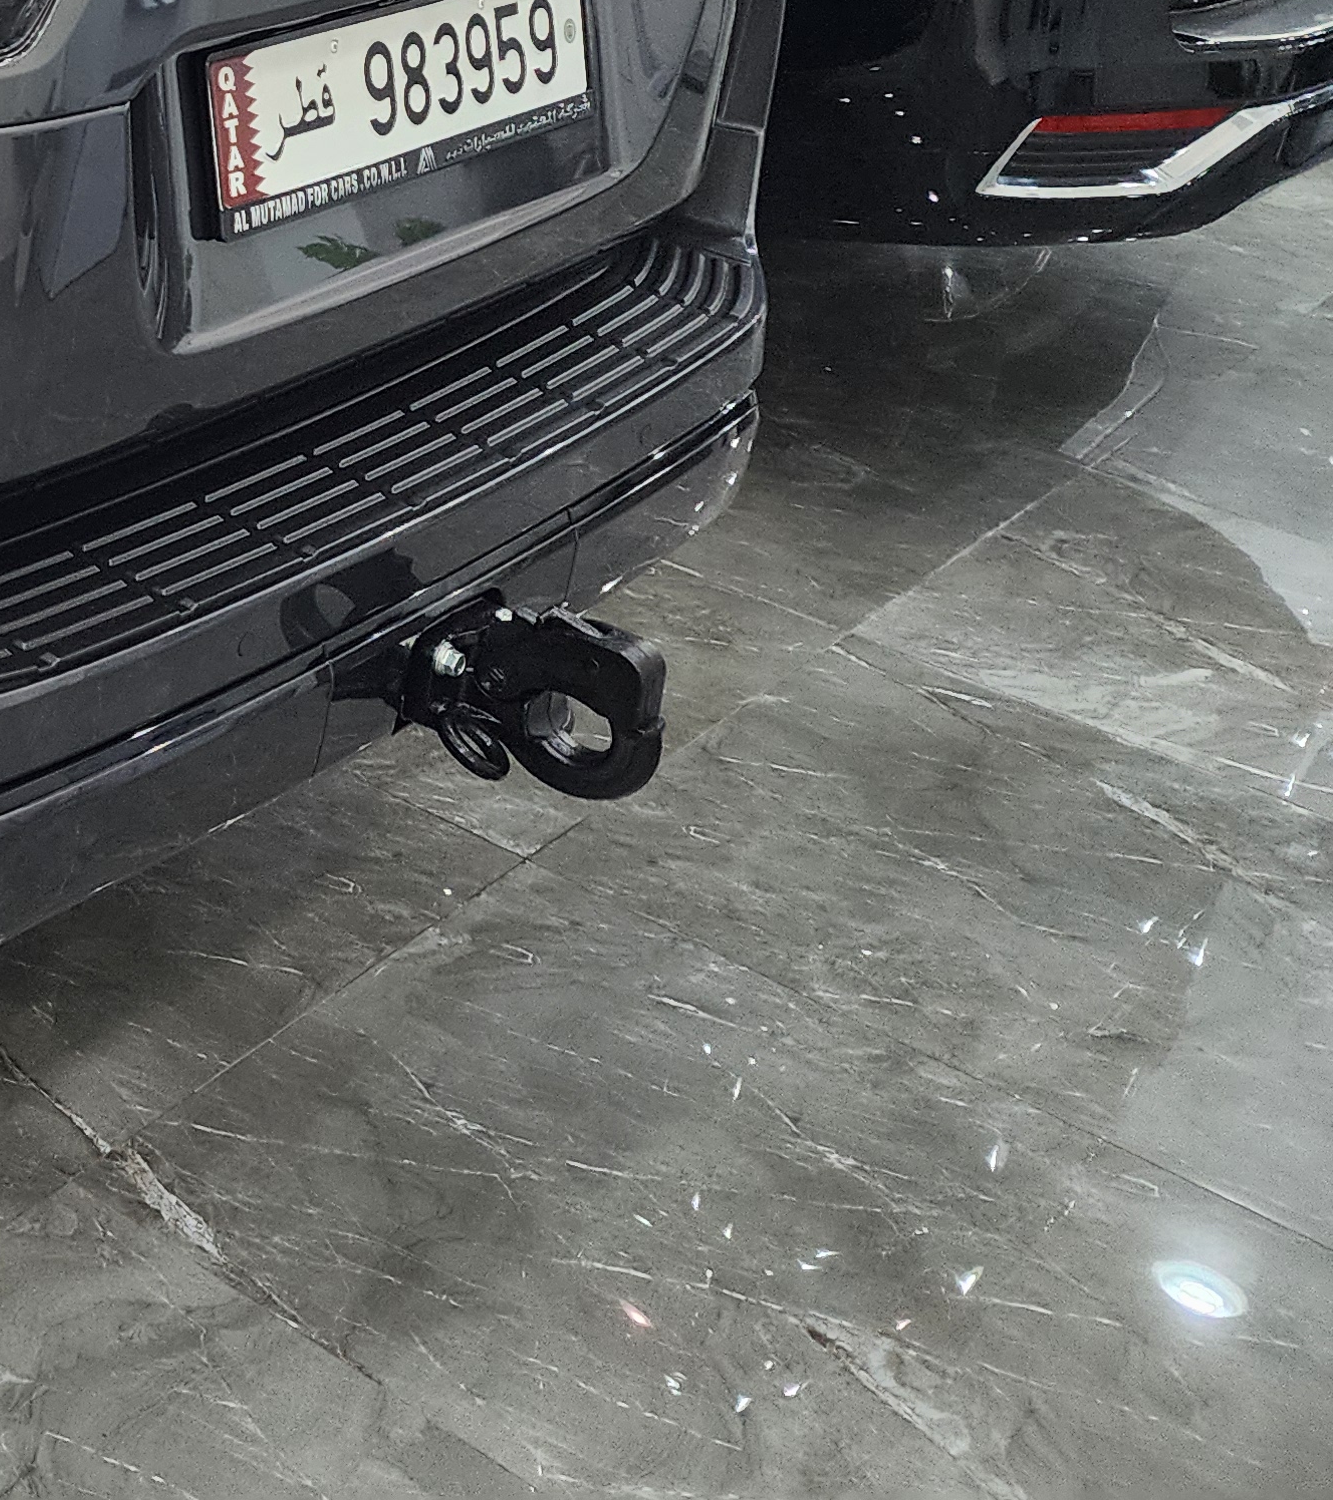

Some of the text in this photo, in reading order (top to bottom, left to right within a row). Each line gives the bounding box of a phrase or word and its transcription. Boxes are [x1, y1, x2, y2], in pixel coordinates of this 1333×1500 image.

[217, 66, 248, 198] QATAR
[265, 62, 336, 162] قطر
[233, 209, 250, 234] AL
[250, 190, 306, 229] MUTAMAD
[307, 182, 329, 210] FOR
[331, 173, 359, 201] CARS
